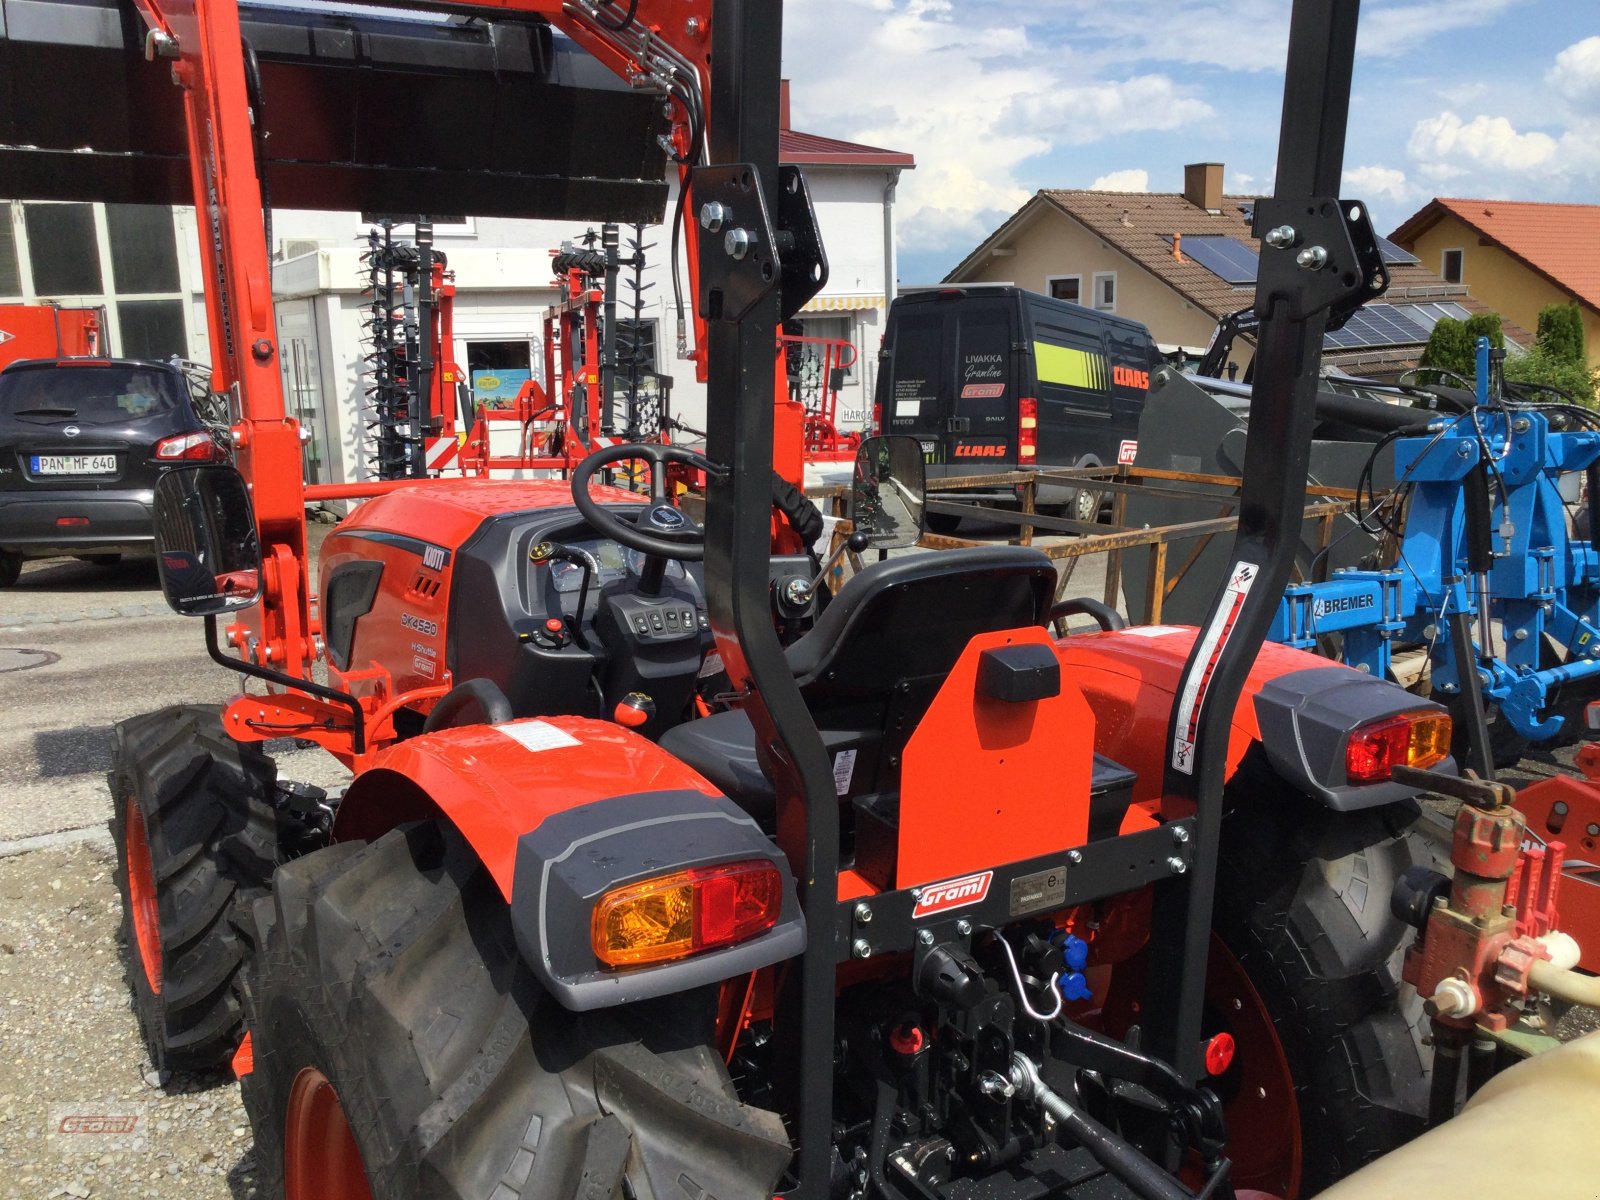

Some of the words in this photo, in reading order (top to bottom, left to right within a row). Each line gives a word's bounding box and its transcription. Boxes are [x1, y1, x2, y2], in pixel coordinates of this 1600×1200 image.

[965, 355, 1002, 363] LIVAKKA
[1113, 366, 1149, 390] CLAAS
[965, 386, 1002, 397] Graml
[955, 446, 1007, 457] CLAAS
[41, 457, 65, 470] PAN
[74, 457, 89, 470] MF
[92, 457, 114, 470] 640
[423, 546, 445, 571] KIOTI
[1324, 593, 1375, 614] BREMER
[400, 612, 438, 637] DK4520
[921, 875, 987, 907] Graml
